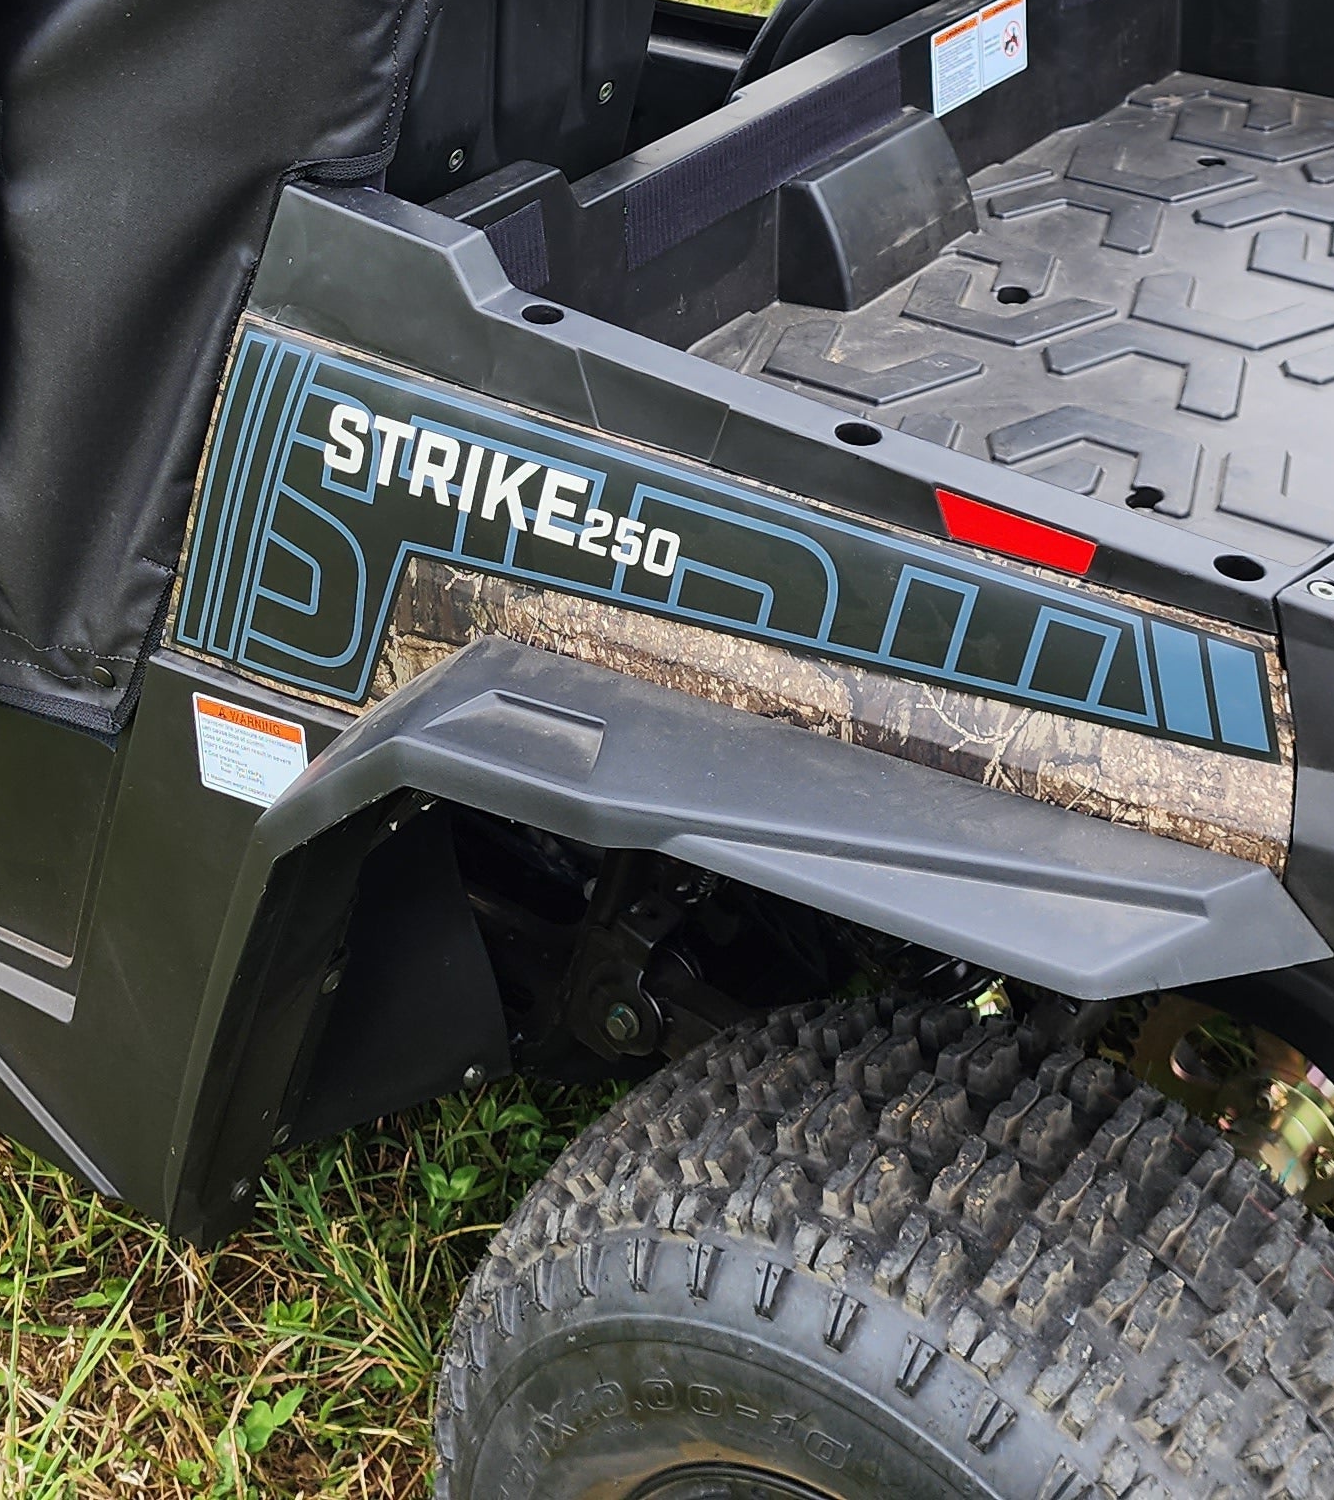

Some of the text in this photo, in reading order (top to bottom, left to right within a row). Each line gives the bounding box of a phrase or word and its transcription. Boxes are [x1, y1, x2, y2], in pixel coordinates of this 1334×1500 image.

[322, 403, 682, 578] STRIKE 250
[229, 710, 280, 735] WARNING
